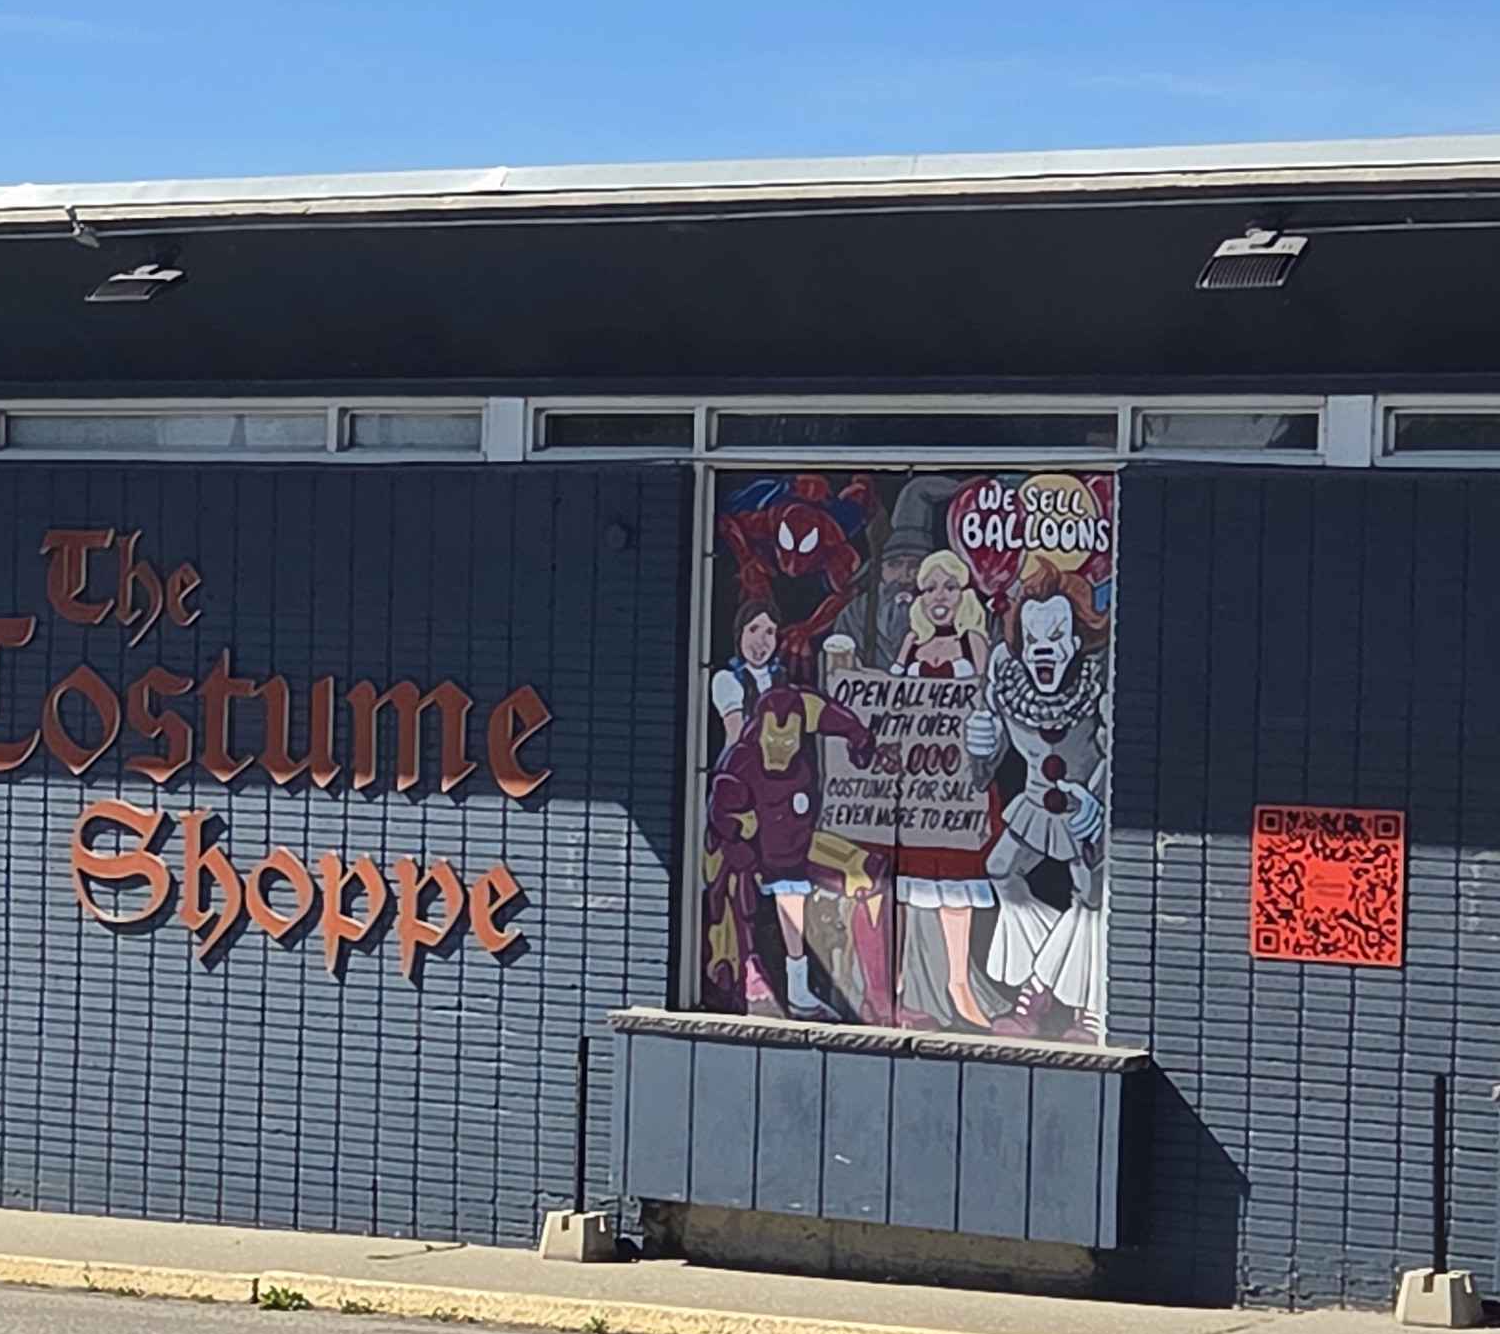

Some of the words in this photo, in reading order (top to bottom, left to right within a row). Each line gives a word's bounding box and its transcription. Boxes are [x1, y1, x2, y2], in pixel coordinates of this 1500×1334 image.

[978, 480, 1015, 511] WE
[1025, 486, 1085, 515] SELL
[962, 512, 1110, 552] BALLOONS
[40, 528, 203, 649] The
[834, 679, 892, 708] OPEN
[892, 682, 926, 710] ALL
[928, 682, 977, 711] YEAR
[869, 712, 914, 737] WITH
[917, 714, 962, 739] OVER
[826, 777, 905, 802] COSTUMES
[907, 778, 938, 803] FOR
[940, 779, 976, 803] SALE
[835, 803, 875, 827] EVEN
[874, 805, 918, 830] MORE
[920, 807, 942, 832] TO
[70, 798, 524, 979] Shoppe
